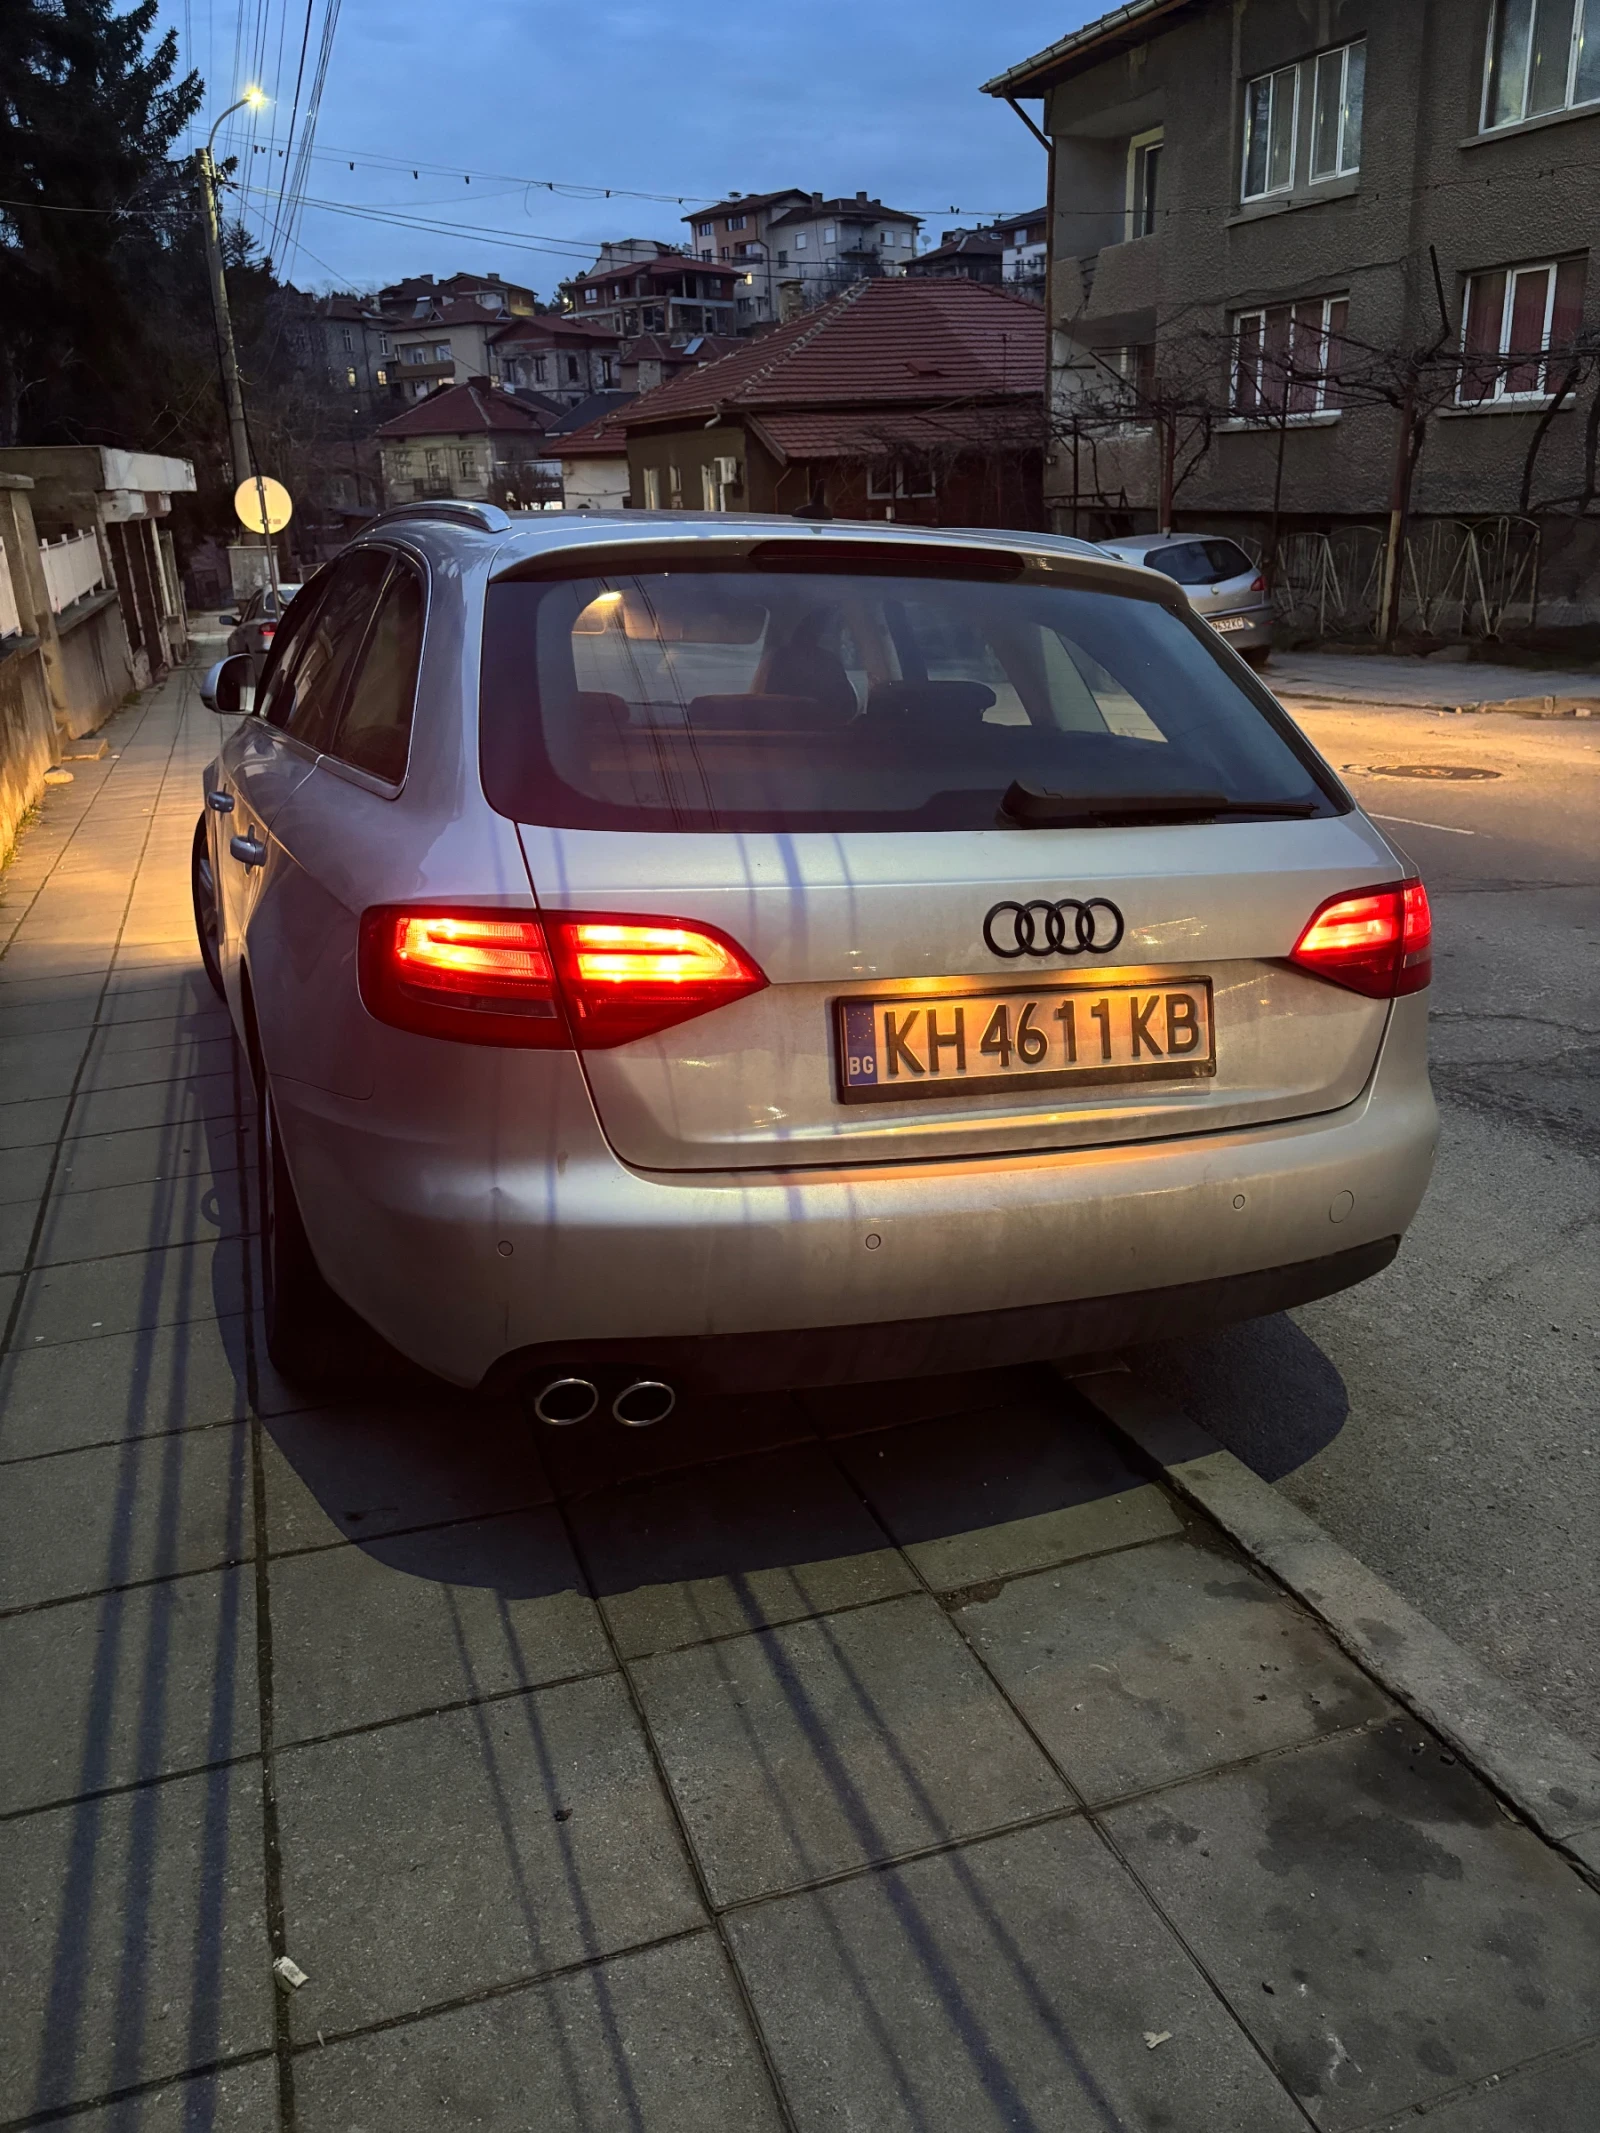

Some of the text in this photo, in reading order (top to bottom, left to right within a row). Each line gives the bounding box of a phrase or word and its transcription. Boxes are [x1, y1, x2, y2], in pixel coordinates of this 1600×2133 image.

[885, 994, 1199, 1074] KH 4611 KB
[849, 1055, 874, 1075] BG
